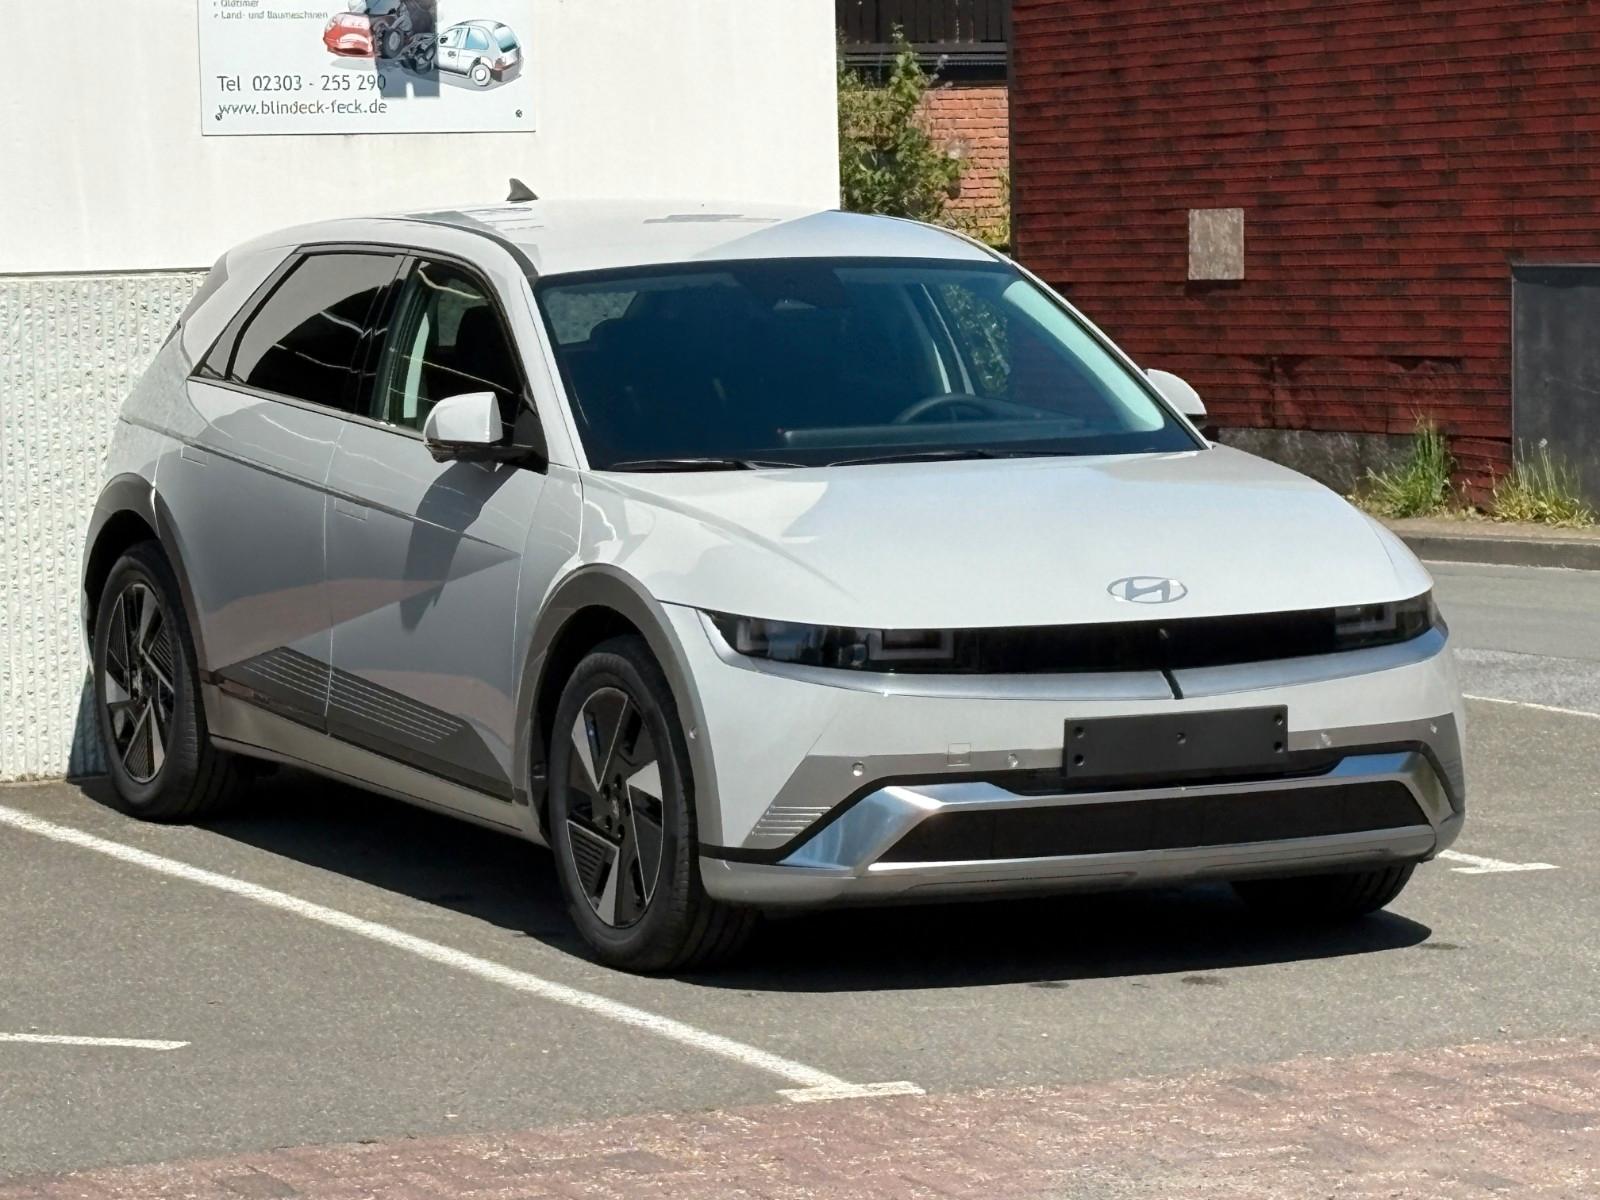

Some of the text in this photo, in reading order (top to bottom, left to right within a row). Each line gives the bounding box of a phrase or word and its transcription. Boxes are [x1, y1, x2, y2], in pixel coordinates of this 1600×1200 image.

[248, 10, 265, 20] und
[216, 75, 241, 91] Tel
[252, 74, 302, 91] 02303
[320, 74, 351, 91] 255
[356, 74, 387, 91] 290
[218, 98, 388, 115] www.blindeck-feck.de
